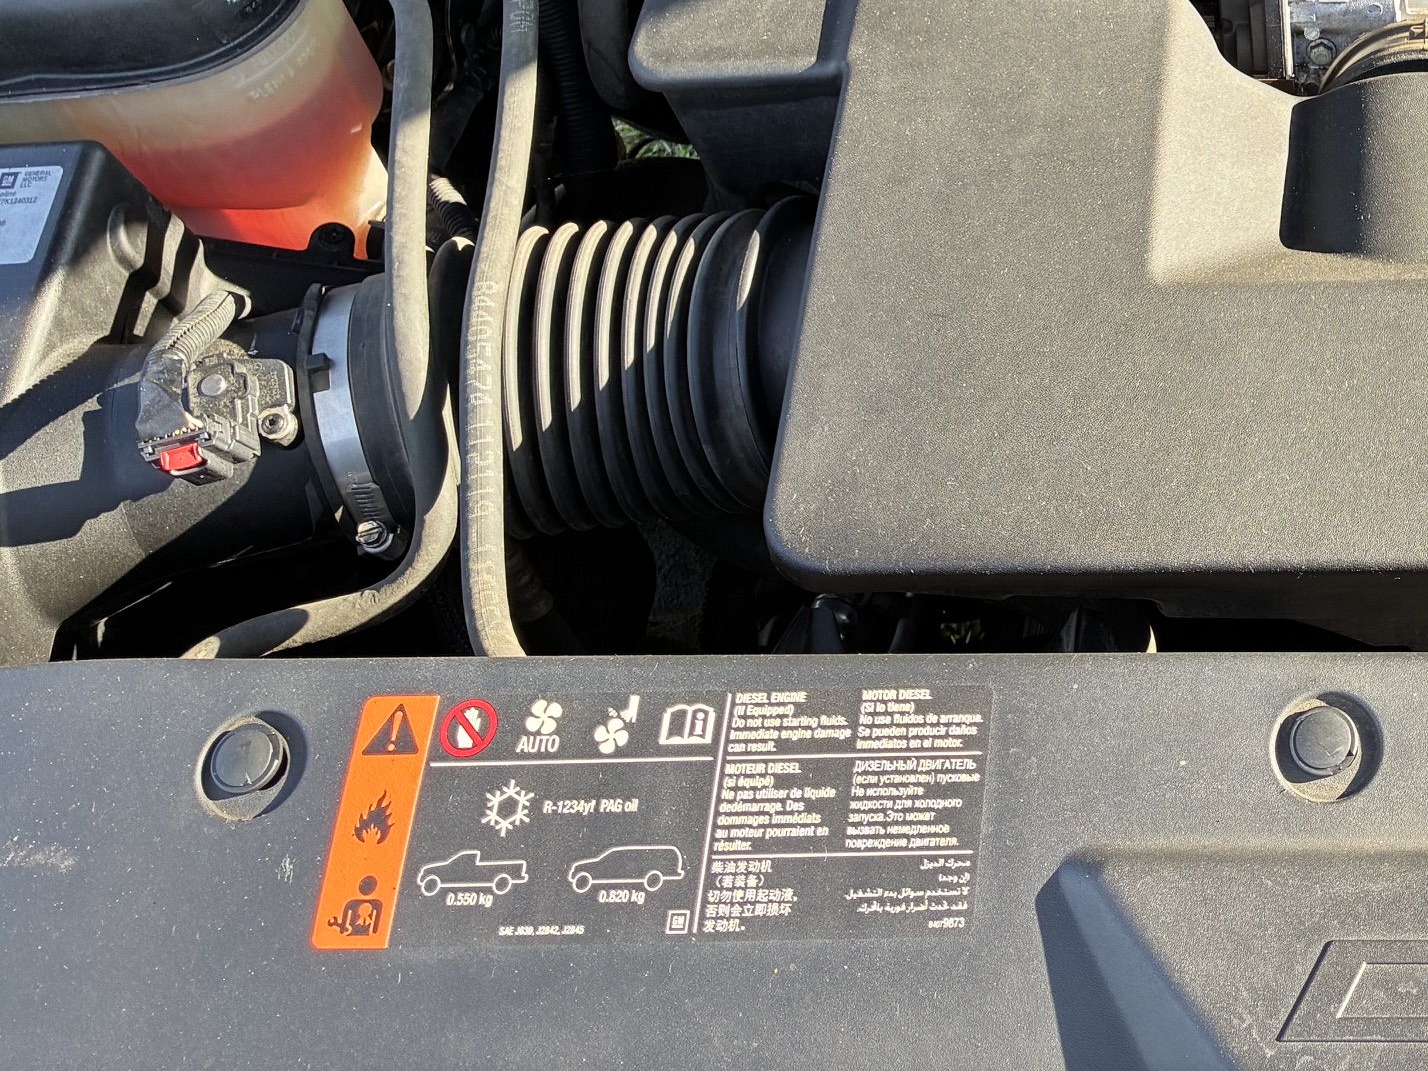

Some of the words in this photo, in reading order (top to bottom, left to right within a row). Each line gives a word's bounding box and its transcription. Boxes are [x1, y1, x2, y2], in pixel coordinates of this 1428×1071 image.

[735, 692, 770, 704] DIESEL
[770, 691, 808, 703] ENGINE
[862, 689, 898, 701] MOTOR
[898, 688, 933, 700] DIESEL
[746, 704, 795, 717] Equipped)
[875, 702, 886, 713] lo
[887, 701, 915, 714] tiene)
[731, 717, 745, 728] Do
[746, 716, 763, 728] not
[763, 718, 782, 727] use
[782, 715, 818, 728] starting
[859, 714, 873, 725] No
[874, 716, 892, 725] use
[893, 713, 925, 724] fluidos
[925, 713, 938, 724] de
[939, 714, 984, 725] arranque.
[729, 729, 779, 741] Immediate
[780, 728, 813, 741] engine
[813, 728, 852, 740] damage
[857, 726, 871, 738] Se
[871, 726, 907, 739] pueden
[908, 725, 948, 738] producir
[948, 724, 978, 736] daños
[516, 735, 560, 753] AUTO
[727, 743, 746, 753] can
[856, 738, 908, 750] inmediatos
[908, 739, 922, 749] en
[922, 737, 933, 748] el
[933, 738, 964, 748] motor.
[724, 762, 766, 775] MOTEUR
[767, 762, 802, 774] DIESEL
[853, 757, 917, 773] ДИЗЕЛЬНЫЙ
[917, 758, 977, 772] ДВИГАТЕЛЬ
[723, 776, 736, 789] (si
[737, 775, 775, 789] équipé)
[852, 774, 878, 786] (если
[879, 772, 935, 786] установлен)
[936, 772, 981, 785] пусковые
[721, 789, 735, 800] Ne
[736, 790, 755, 802] pas
[755, 788, 789, 799] utiliser
[789, 787, 803, 799] de
[803, 786, 837, 800] liquide
[851, 786, 865, 797] Не
[866, 784, 925, 798] используйте
[543, 799, 596, 815] R-1234yf
[599, 799, 623, 813] PAG
[624, 798, 639, 812] oil
[786, 800, 805, 811] Des
[849, 798, 893, 811] жидкости
[894, 798, 913, 810] для
[913, 797, 963, 809] холодного
[717, 814, 770, 827] dommages
[771, 812, 822, 825] immédiats
[905, 811, 937, 822] может
[714, 828, 729, 839] au
[729, 827, 764, 838] moteur
[765, 826, 815, 840] pourraient
[816, 825, 830, 837] en
[846, 825, 886, 836] вызвать
[886, 824, 951, 836] немедленное
[845, 837, 908, 850] повреждение
[908, 836, 960, 849] двигателя.
[711, 859, 773, 874] 柴油发动机
[945, 858, 971, 872] محرك
[447, 893, 477, 907] 0.550
[478, 892, 494, 907] kg
[599, 890, 629, 904] 0.820
[631, 889, 646, 904] kg
[705, 903, 792, 918] 否则会立即损坏
